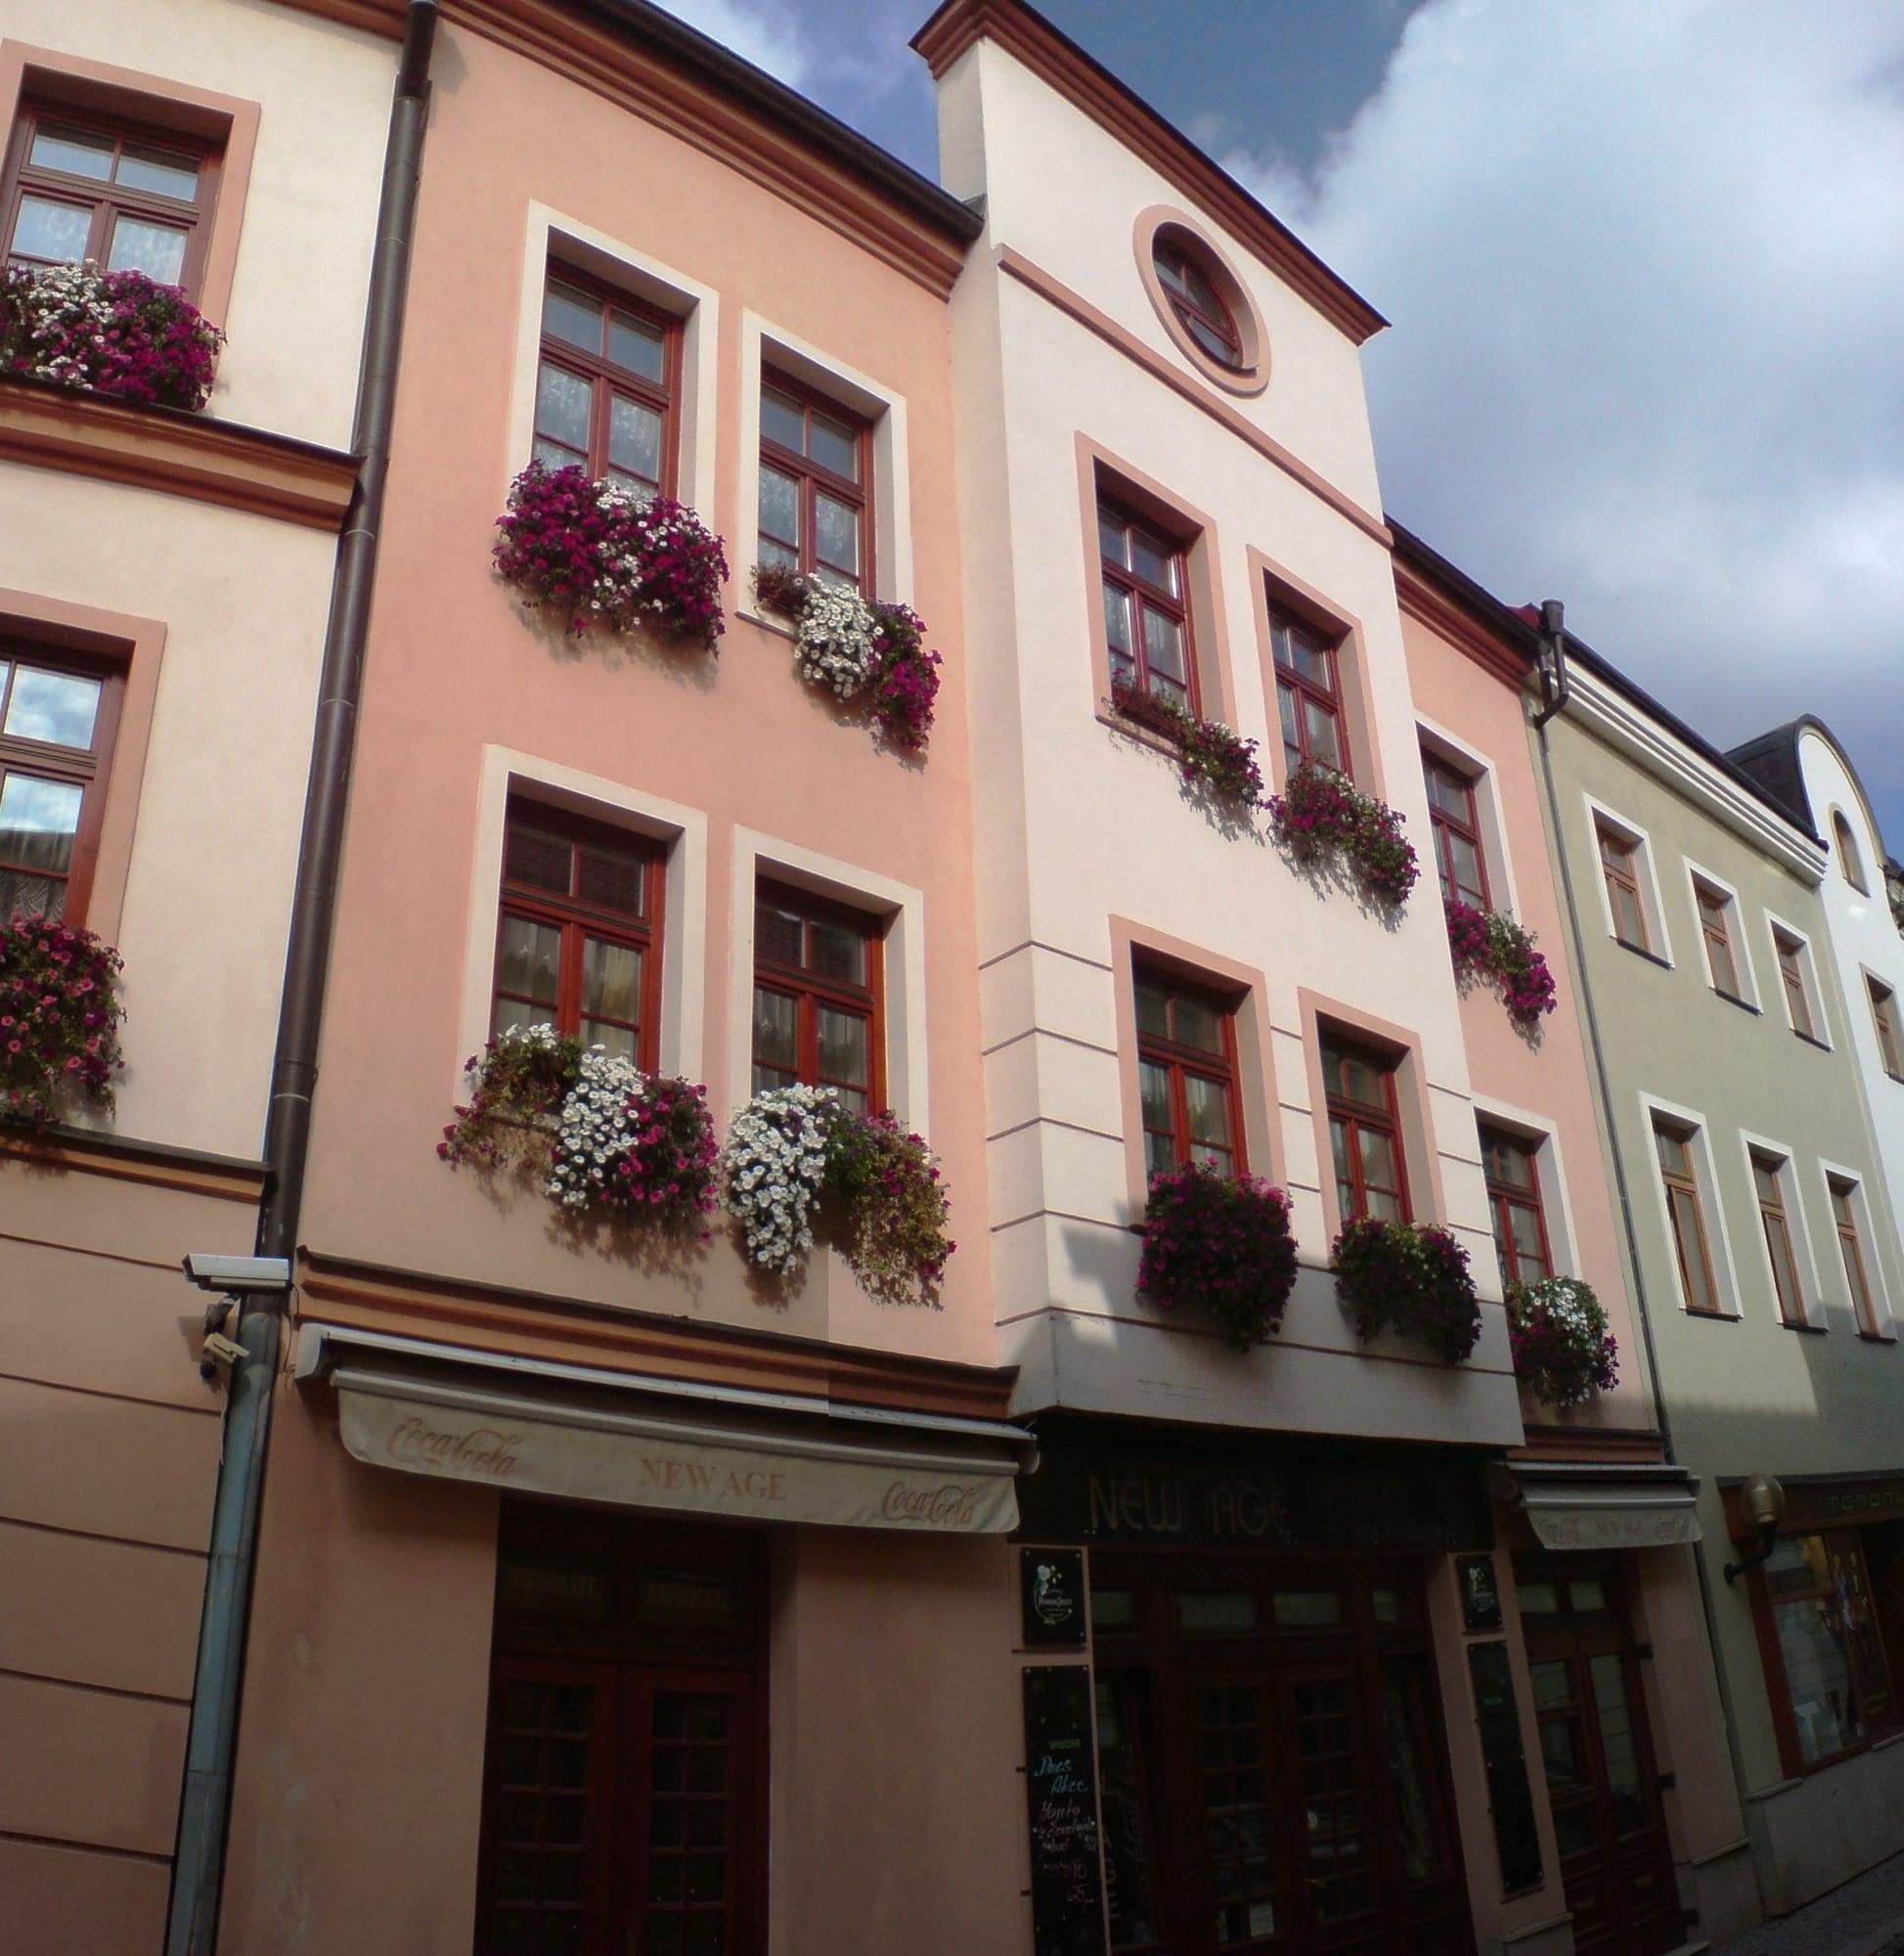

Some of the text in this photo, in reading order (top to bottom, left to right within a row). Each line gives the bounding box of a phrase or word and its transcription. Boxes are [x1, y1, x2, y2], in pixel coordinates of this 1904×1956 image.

[641, 1458, 786, 1501] NEW AGE
[1087, 1474, 1292, 1536] NEW AGE
